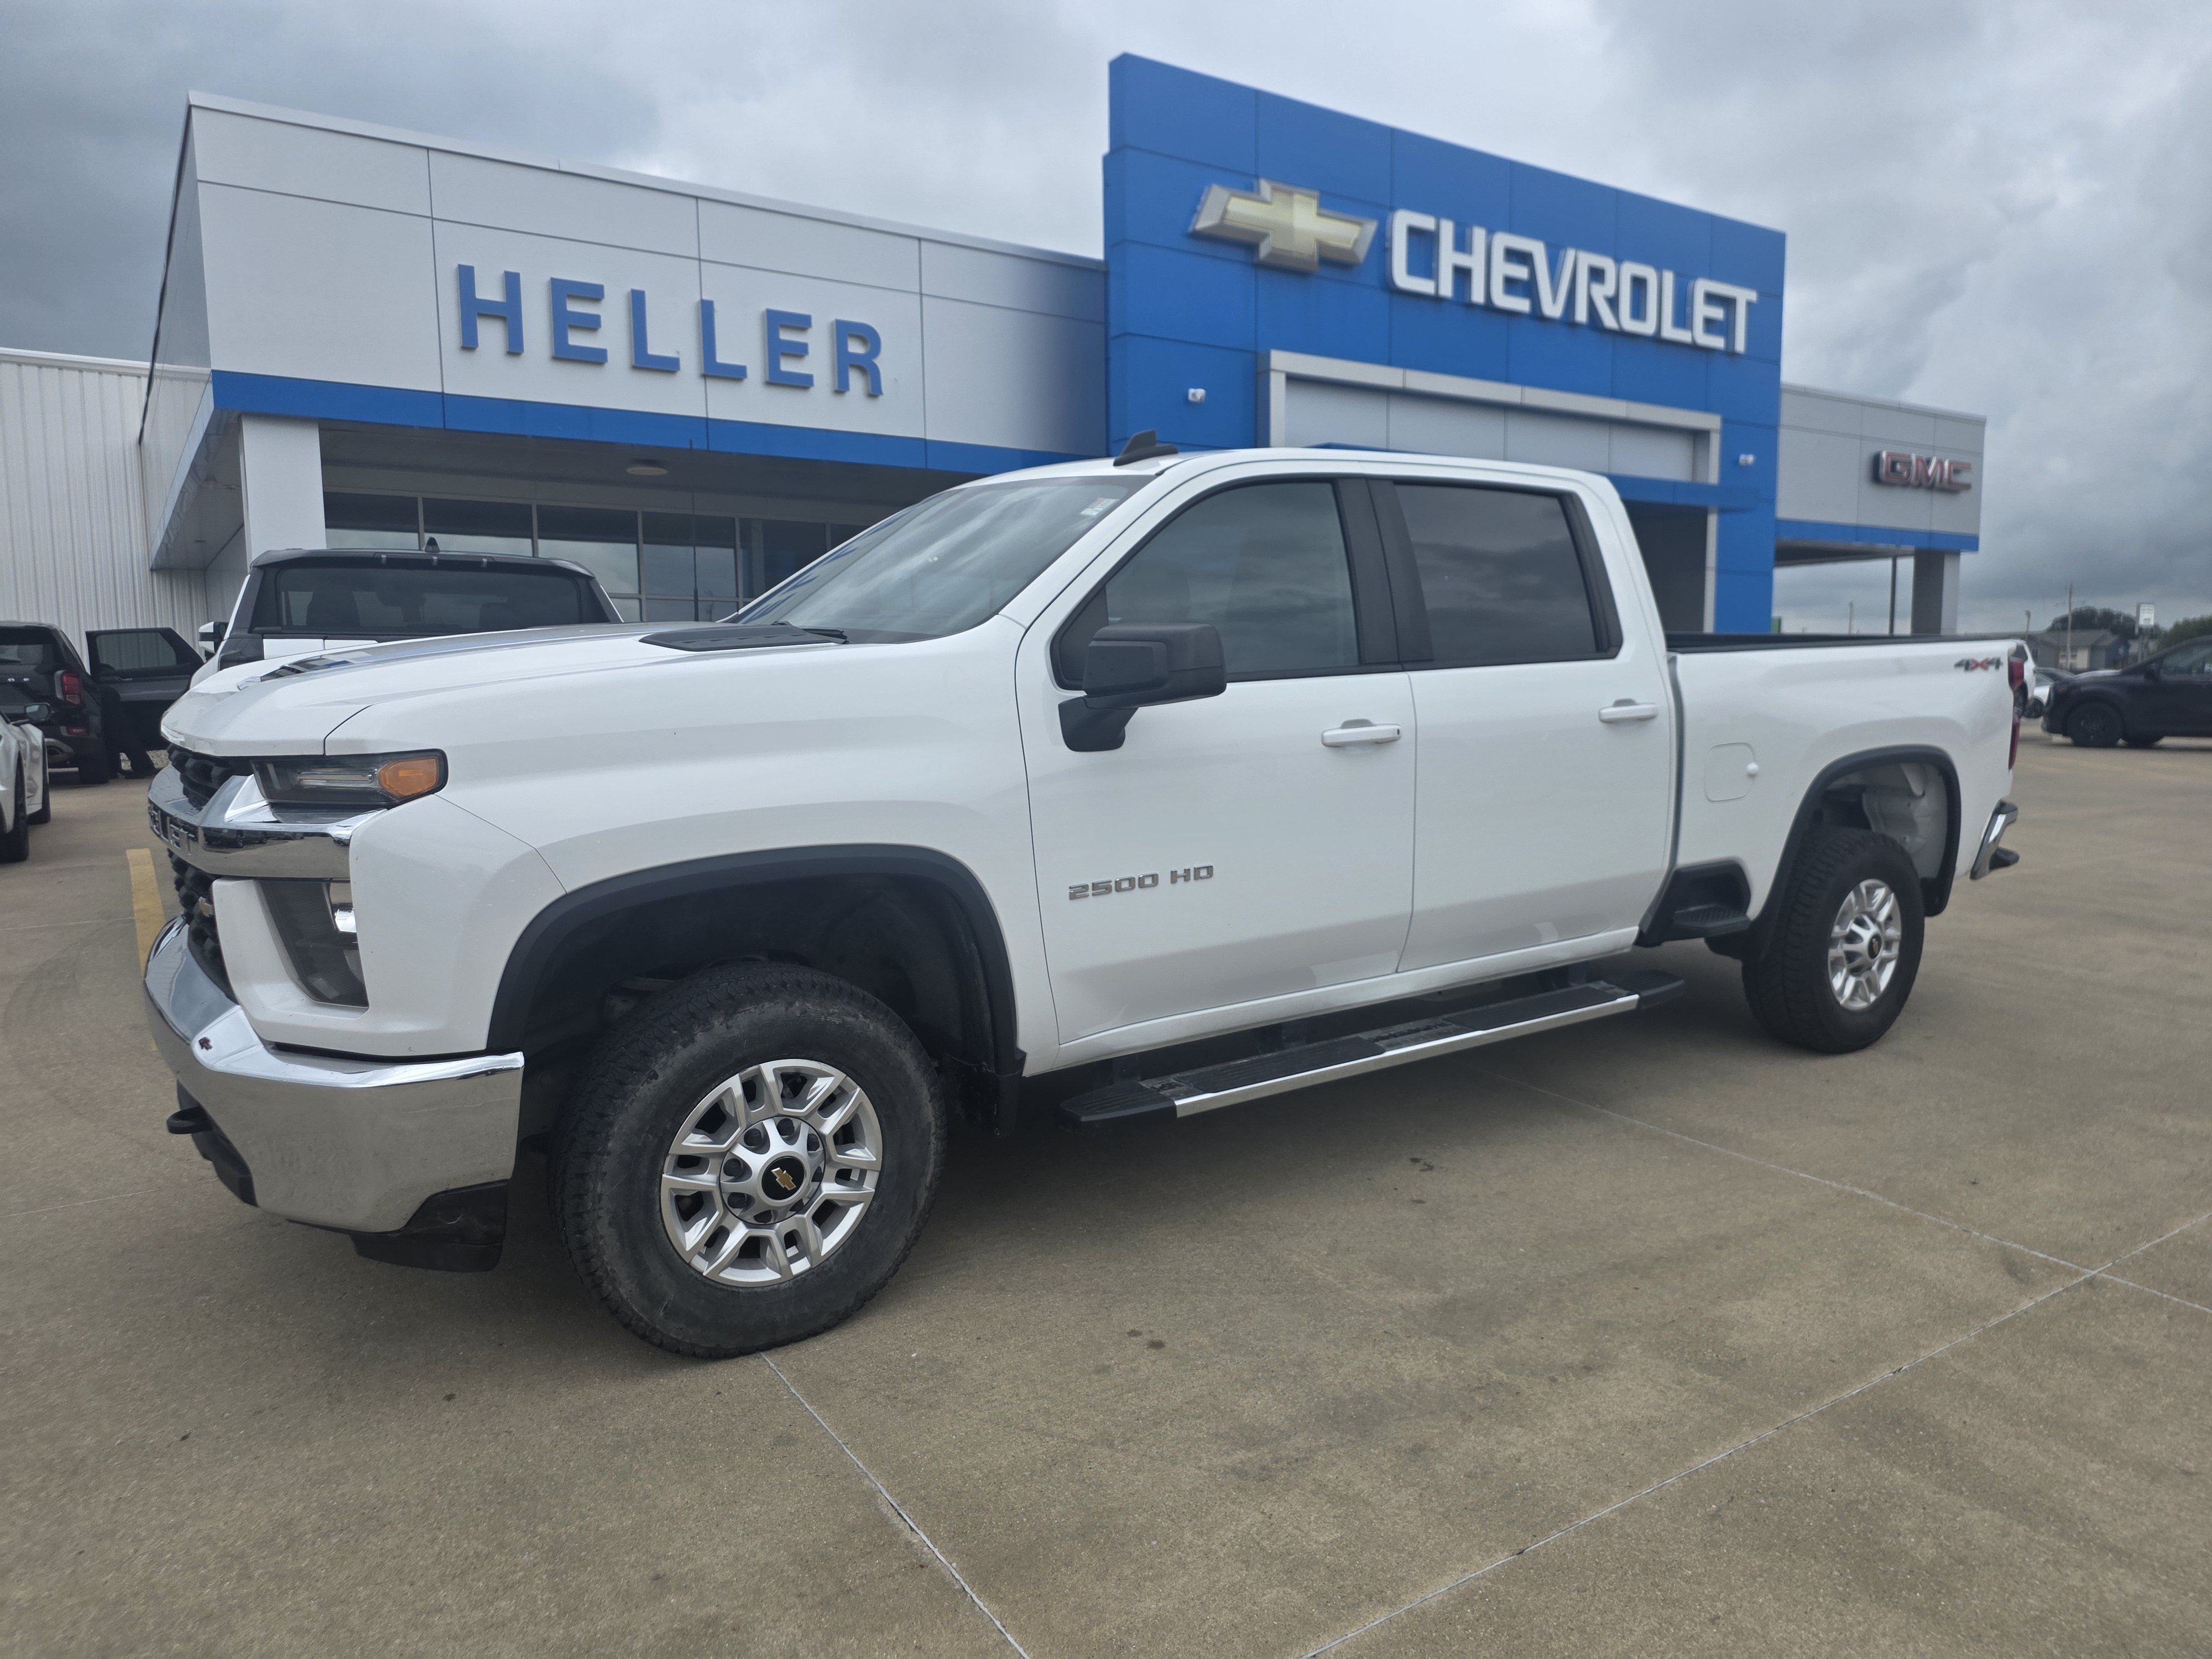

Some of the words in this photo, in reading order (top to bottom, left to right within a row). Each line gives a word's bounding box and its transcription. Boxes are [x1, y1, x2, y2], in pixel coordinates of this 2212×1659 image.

[1390, 208, 1757, 354] CHEVROLET
[457, 263, 884, 396] HELLER
[1879, 450, 1972, 491] GMC
[1069, 872, 1159, 900] 2500
[1170, 864, 1214, 884] HD
